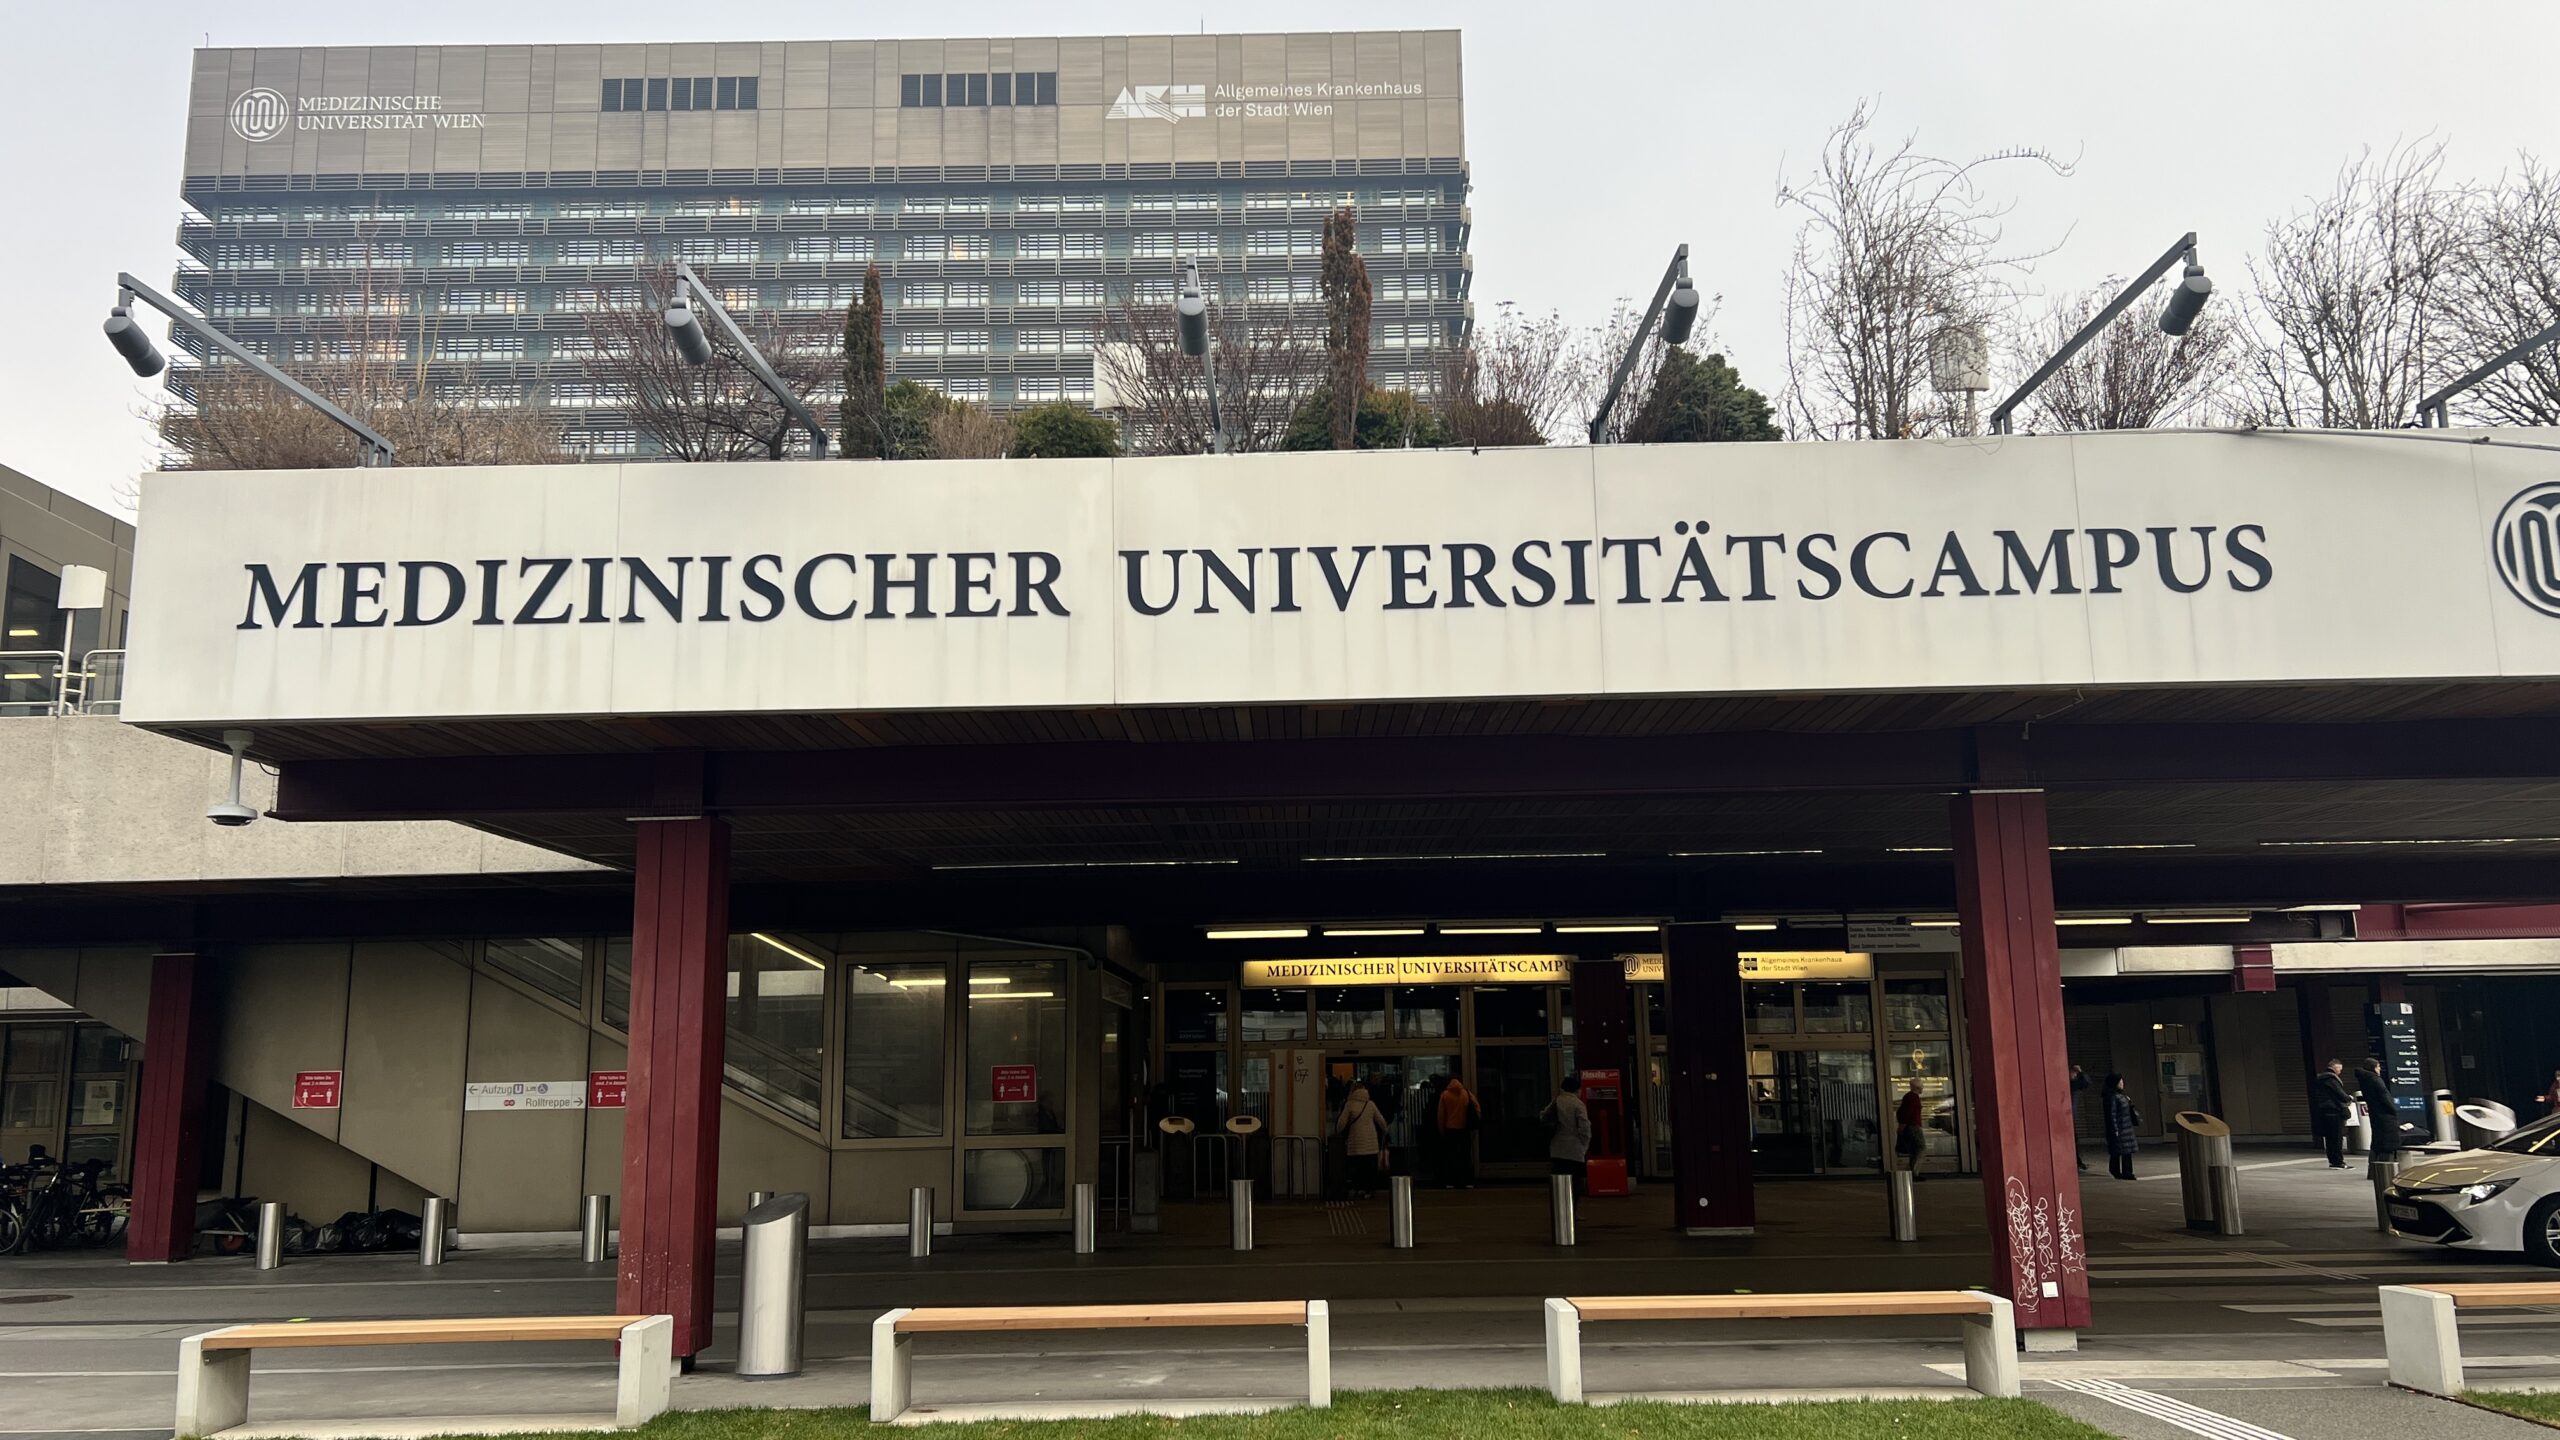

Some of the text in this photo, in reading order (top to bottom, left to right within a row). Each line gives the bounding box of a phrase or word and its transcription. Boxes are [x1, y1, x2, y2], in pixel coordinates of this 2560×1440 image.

[1215, 82, 1423, 101] Allgemeines Krankenhaus
[298, 95, 443, 112] MEDIZINISCHE
[1215, 102, 1333, 118] der Stadt Wien
[298, 113, 487, 131] UNIVERSITÄT WIEN
[236, 521, 2274, 630] MEDIZINISCHER UNIVERSITÄTSCAMPUS
[1266, 958, 1571, 978] MEDIZINISCHER UNIVERSITÄTSCAMPU
[481, 1085, 512, 1096] Aufzug
[525, 1098, 570, 1107] Rolltreppe
